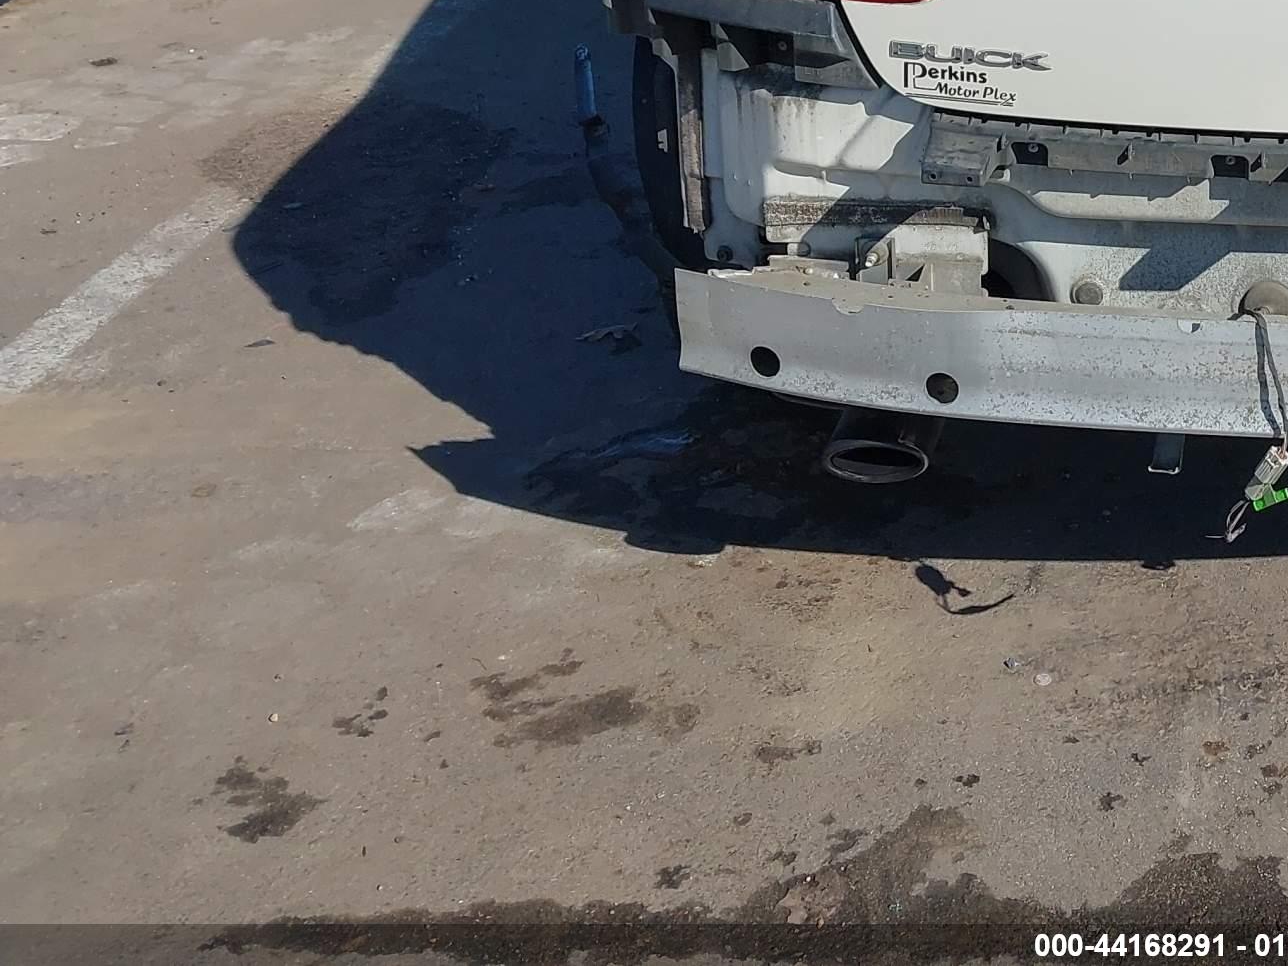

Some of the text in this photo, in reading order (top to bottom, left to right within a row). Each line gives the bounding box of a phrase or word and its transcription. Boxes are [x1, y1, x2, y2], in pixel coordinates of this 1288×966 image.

[888, 40, 1052, 71] BUICK
[903, 62, 988, 88] Perkins
[936, 82, 1017, 102] Motor Plex
